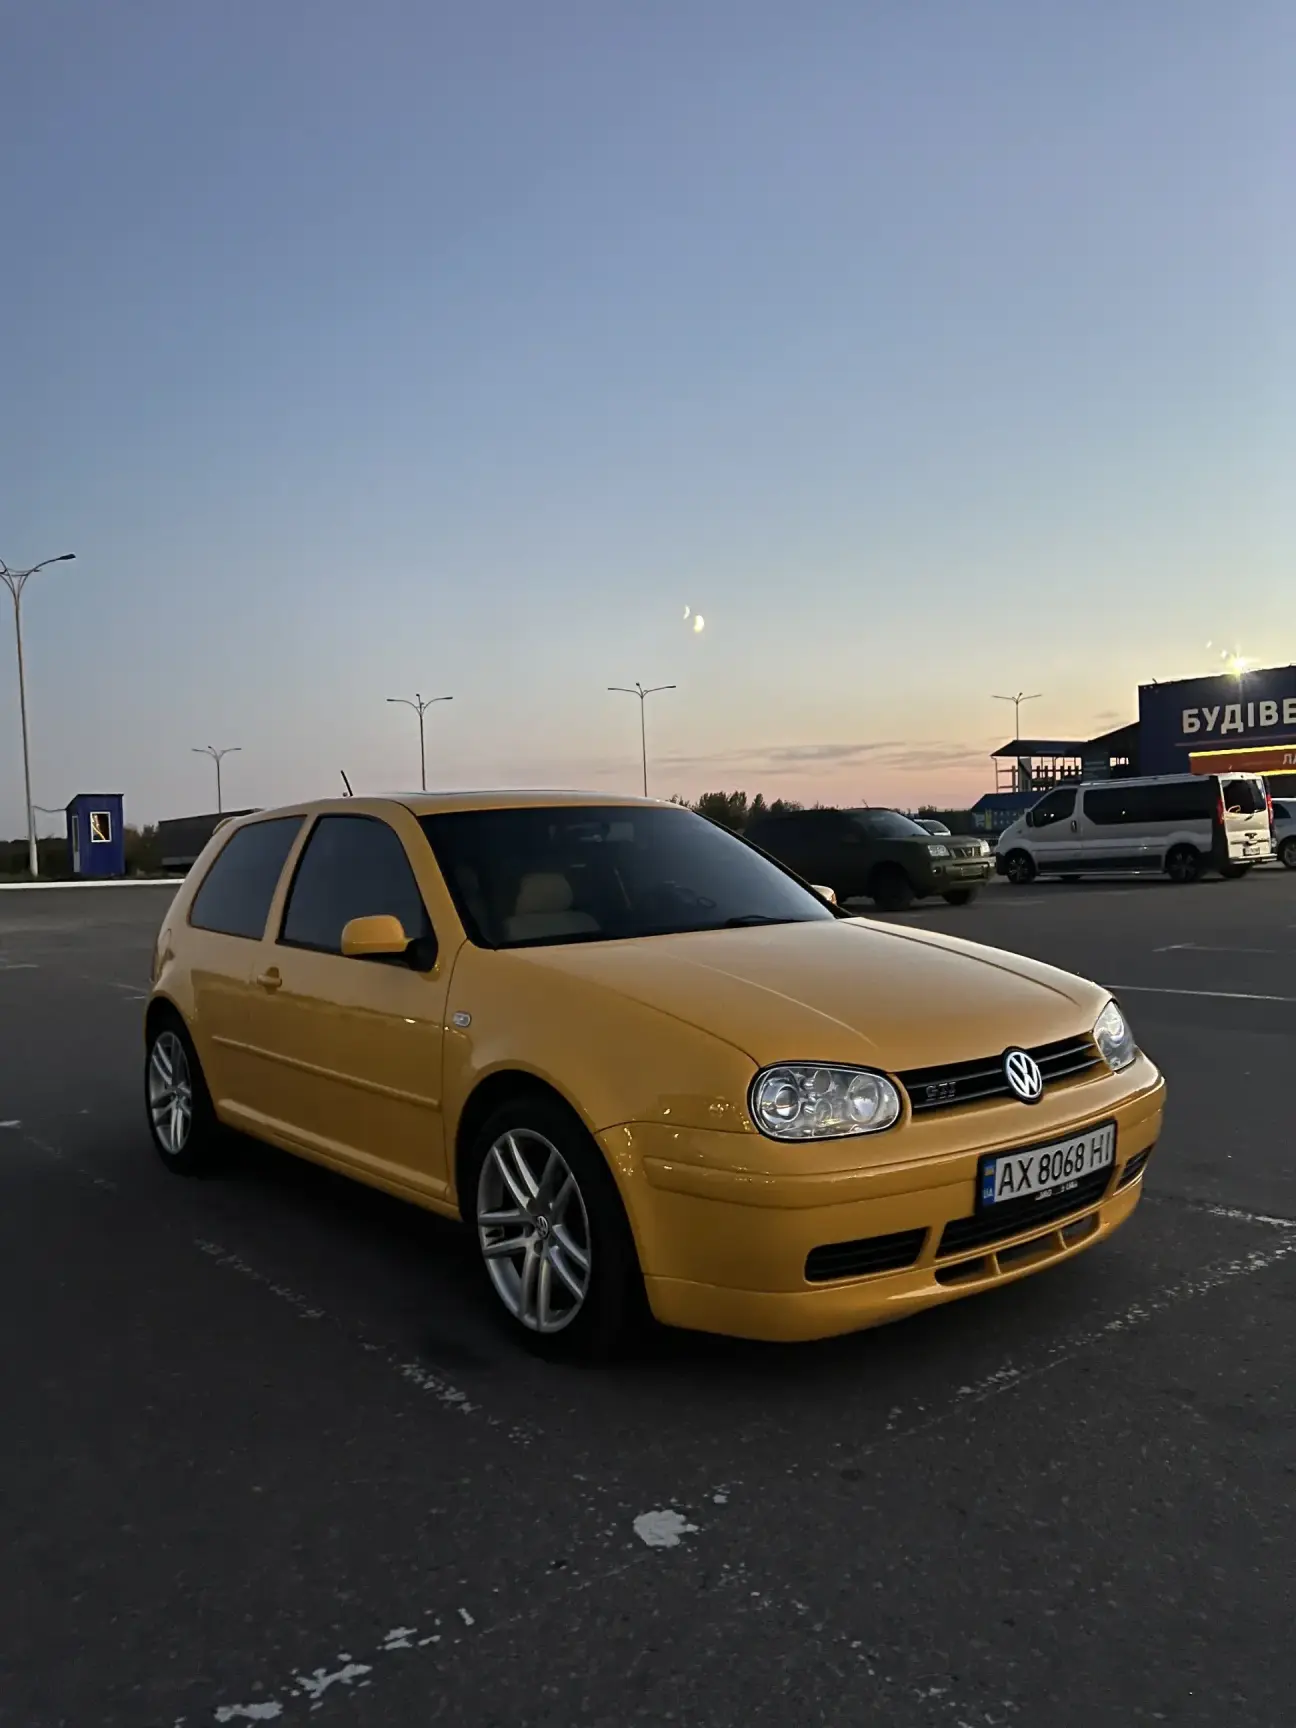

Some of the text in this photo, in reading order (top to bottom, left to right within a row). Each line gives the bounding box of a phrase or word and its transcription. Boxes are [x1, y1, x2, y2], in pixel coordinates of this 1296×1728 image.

[1182, 698, 1296, 734] БУДІВЕ
[1006, 1051, 1042, 1098] VW
[998, 1157, 1034, 1196] AX
[1038, 1142, 1085, 1185] 8068
